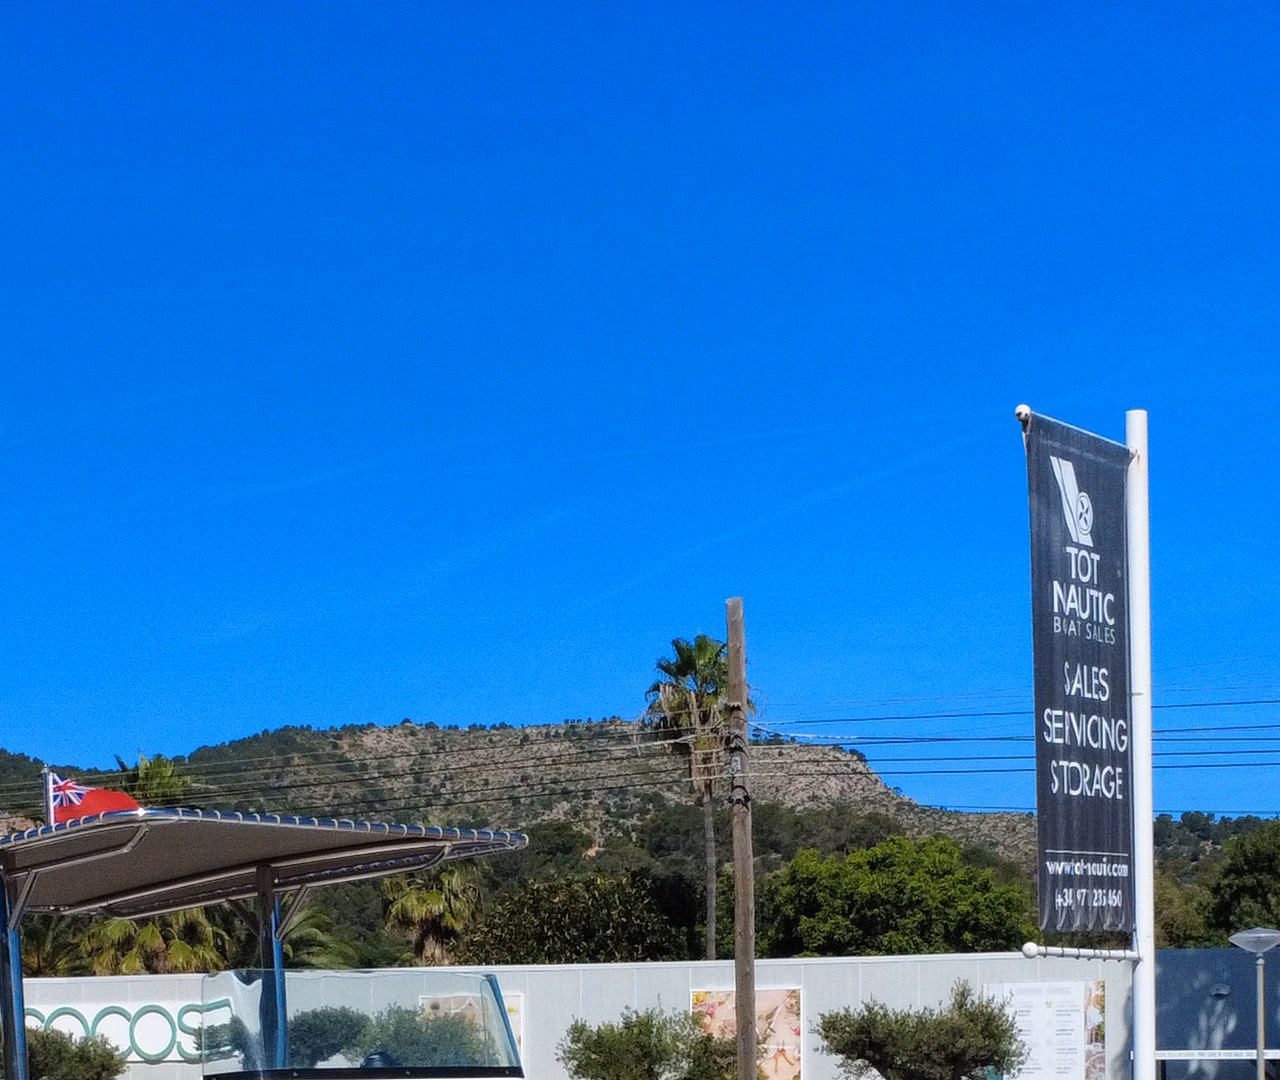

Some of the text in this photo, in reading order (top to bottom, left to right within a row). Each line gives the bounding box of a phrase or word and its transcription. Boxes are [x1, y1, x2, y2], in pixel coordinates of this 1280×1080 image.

[1065, 546, 1100, 585] TOT
[1053, 580, 1114, 626] NAUTIC
[1086, 622, 1115, 645] SALES
[1064, 661, 1109, 701] SALES
[1051, 760, 1123, 799] STORAGE
